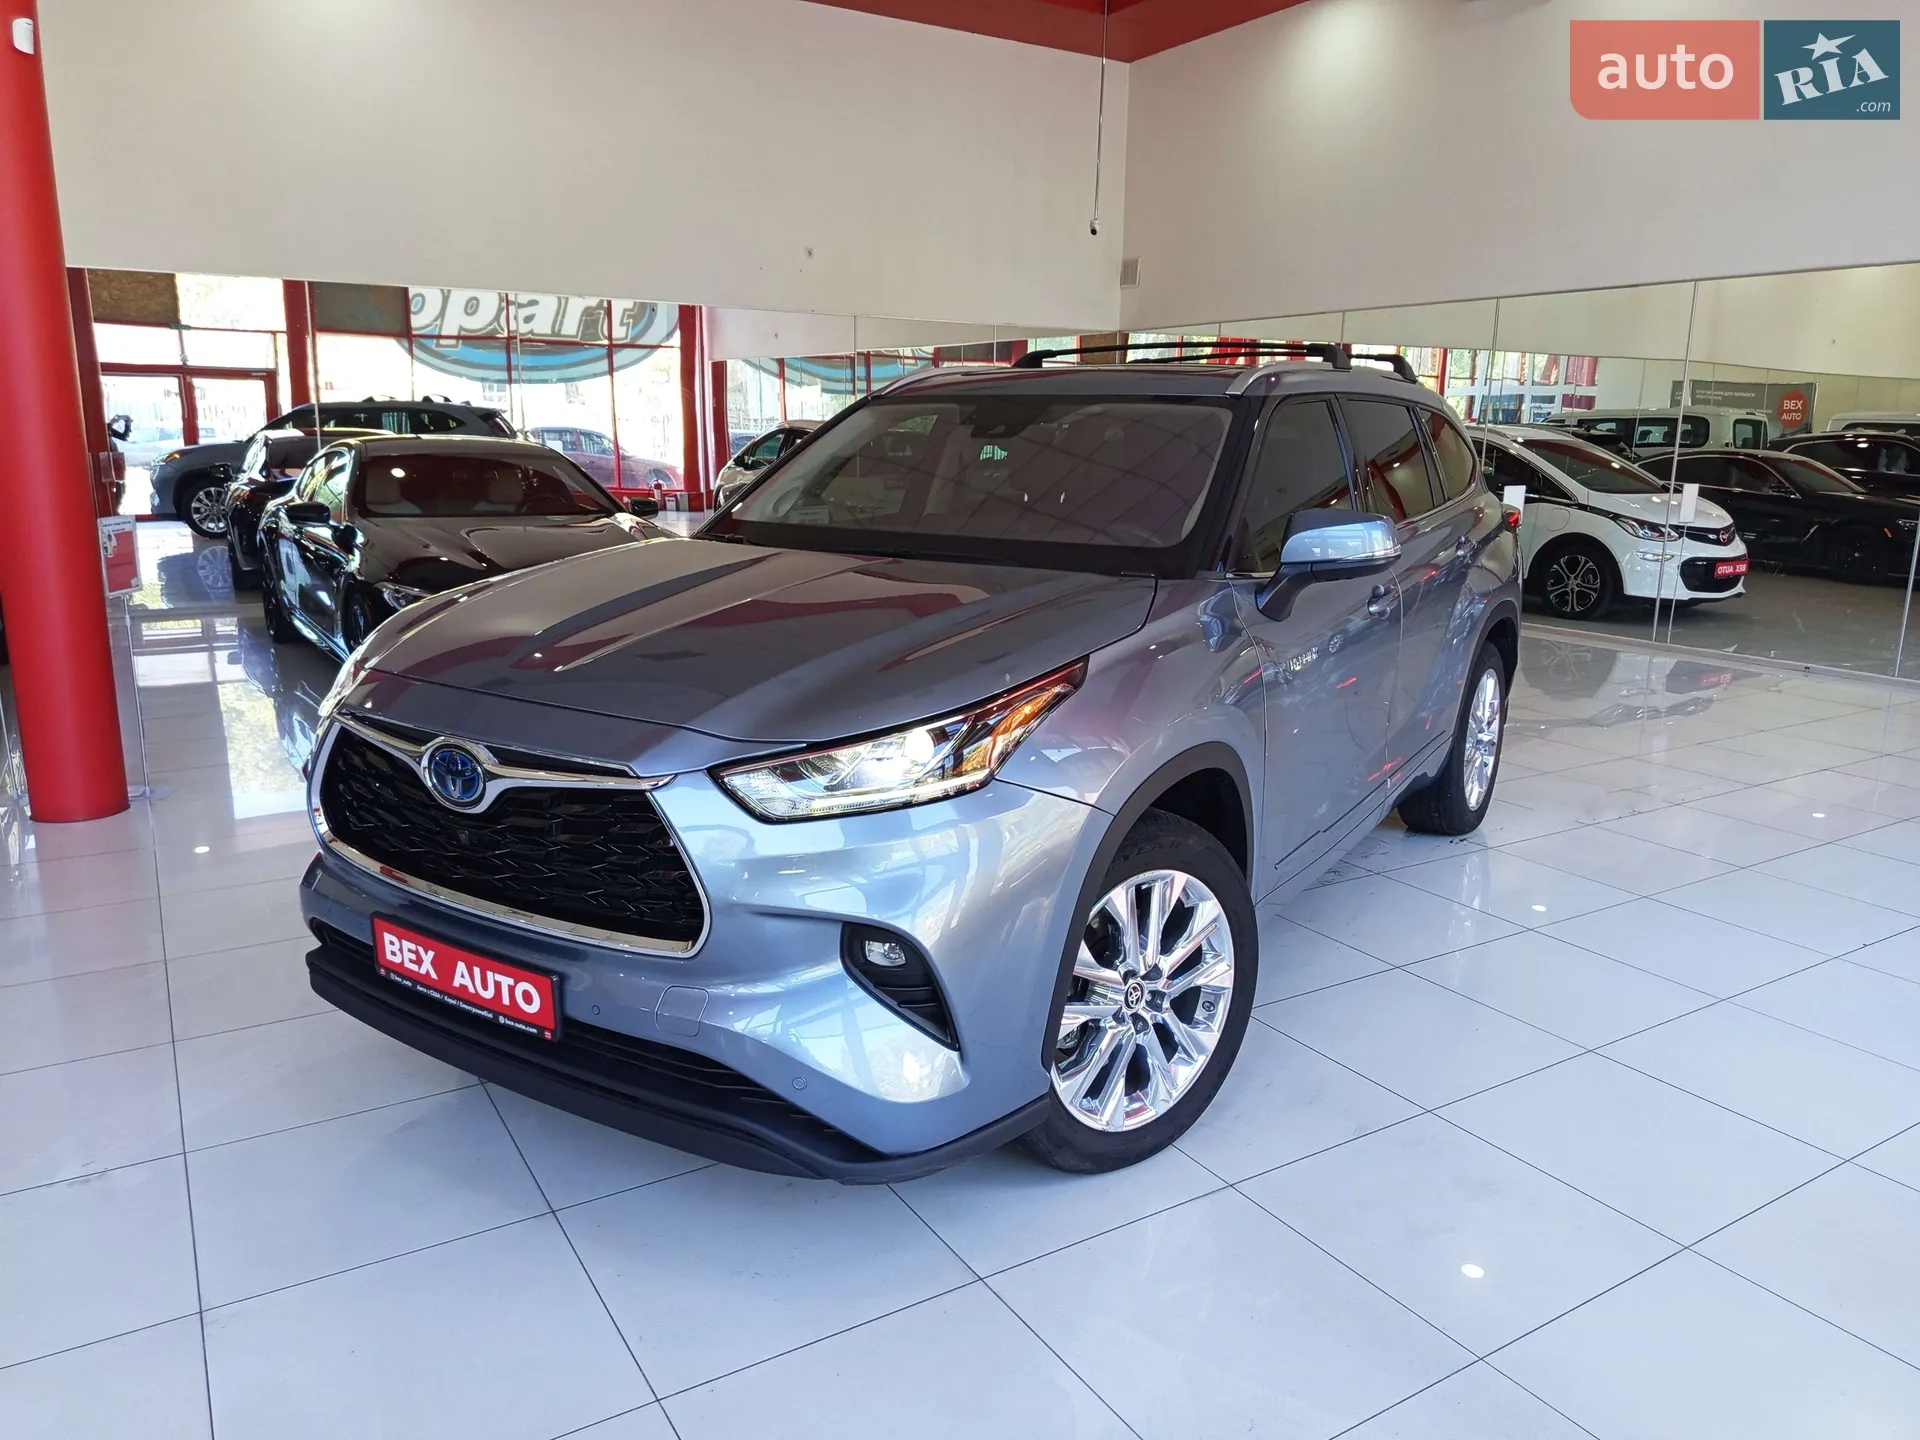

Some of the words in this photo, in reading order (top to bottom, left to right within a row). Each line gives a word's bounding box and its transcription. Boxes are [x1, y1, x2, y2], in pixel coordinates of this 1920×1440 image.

[1783, 400, 1803, 410] BEX
[383, 931, 439, 981] BEX
[452, 961, 541, 1014] AUTO
